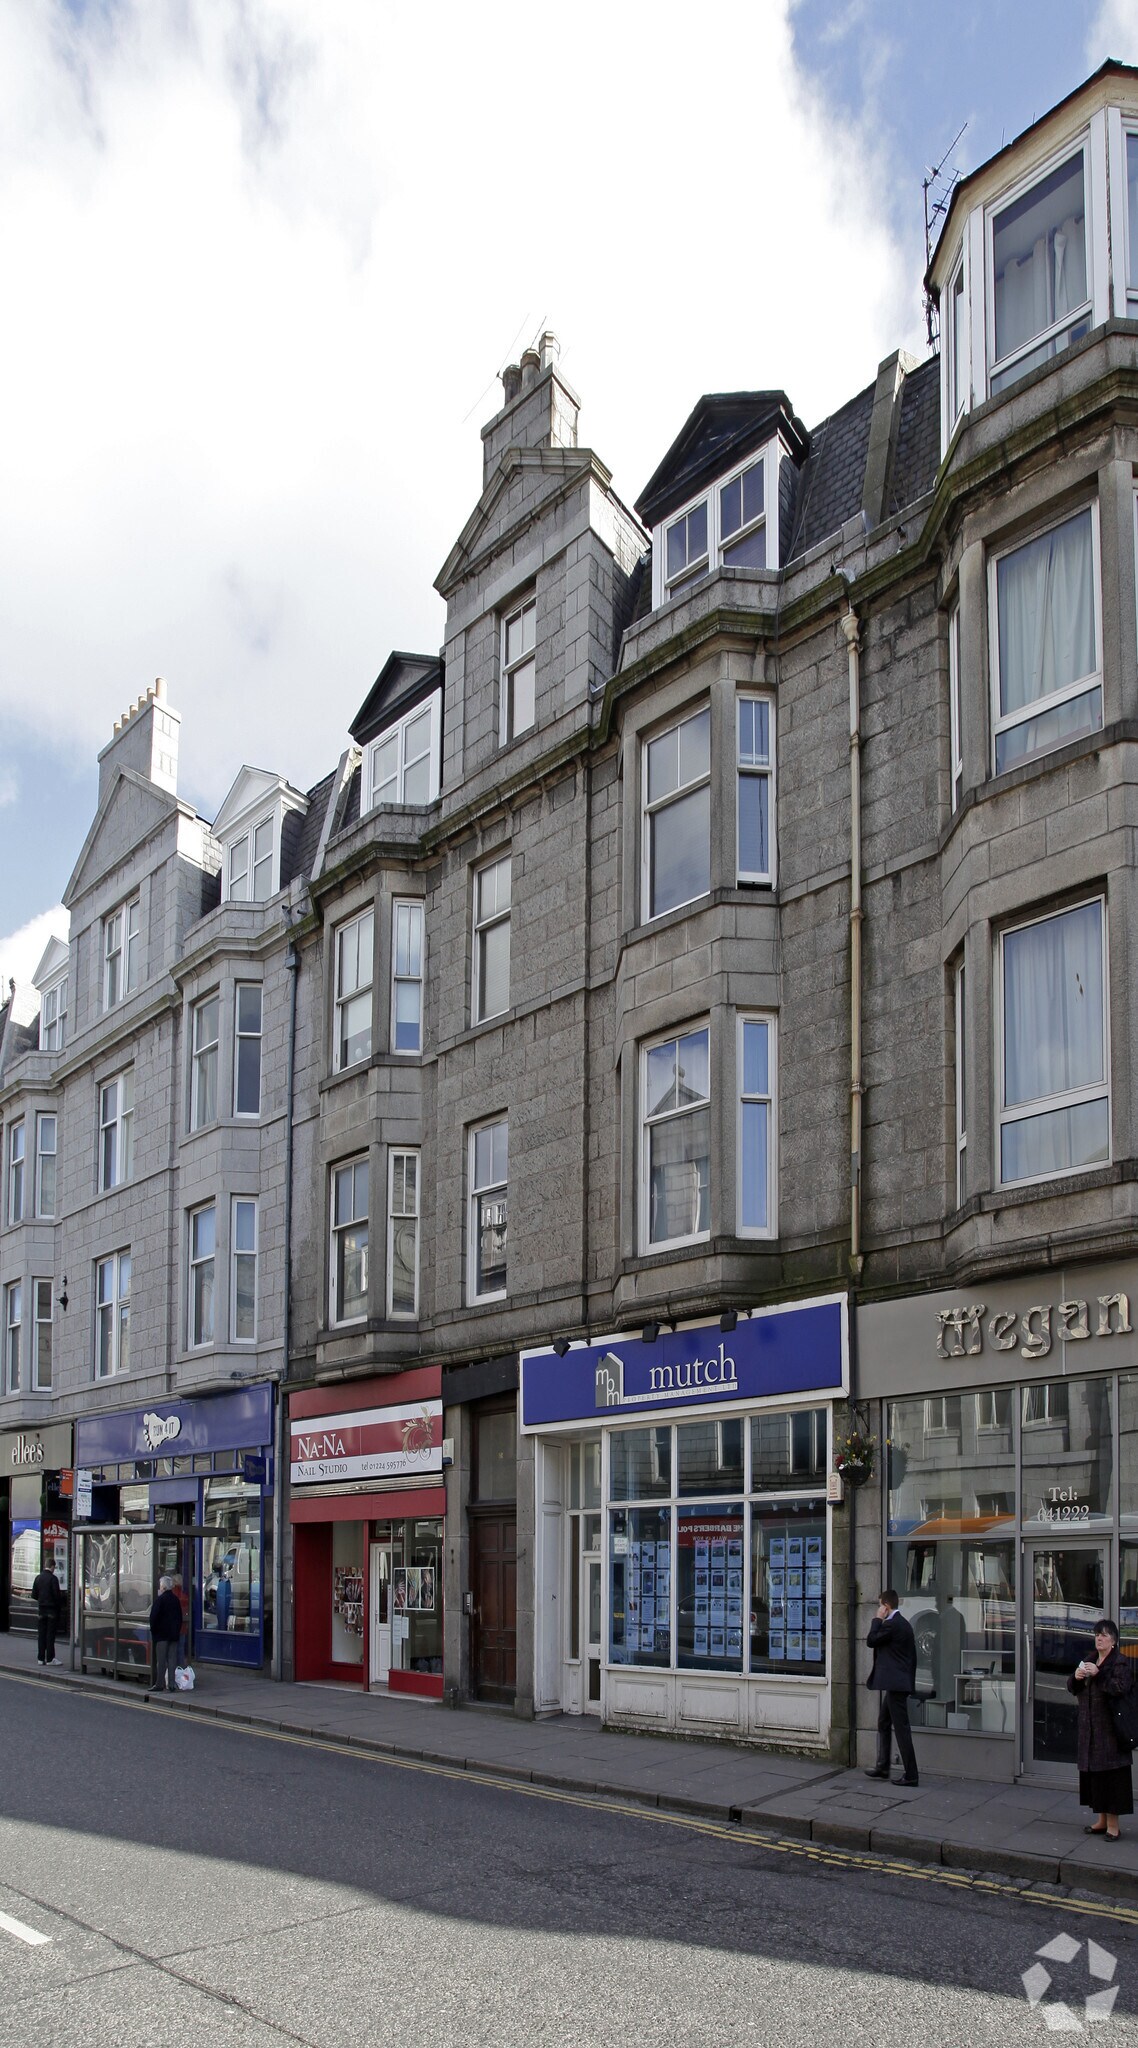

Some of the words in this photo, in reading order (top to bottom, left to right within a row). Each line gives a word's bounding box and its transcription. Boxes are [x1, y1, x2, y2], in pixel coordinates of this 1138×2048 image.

[934, 1292, 1133, 1359] Megan
[649, 1342, 738, 1390] mutch
[664, 1386, 719, 1399] MANAGEMENT
[11, 1433, 45, 1466] ellee's
[361, 1461, 370, 1471] tel
[369, 1462, 386, 1471] 01224
[386, 1459, 407, 1471] 595776
[1048, 1485, 1078, 1502] Tel:
[1037, 1504, 1090, 1523] 641222
